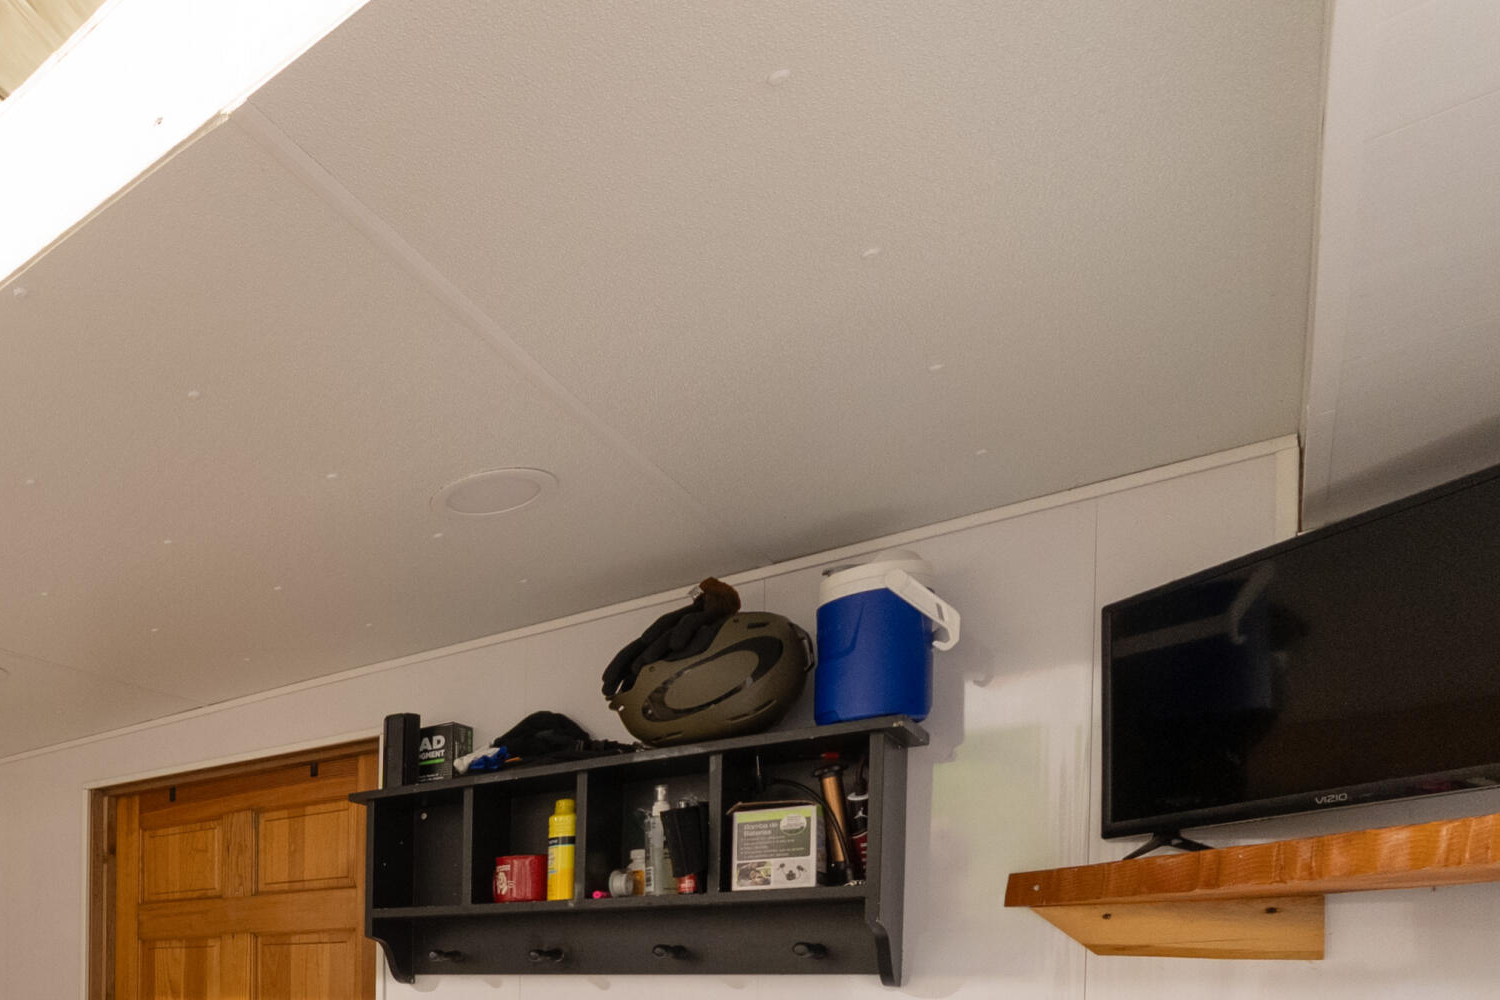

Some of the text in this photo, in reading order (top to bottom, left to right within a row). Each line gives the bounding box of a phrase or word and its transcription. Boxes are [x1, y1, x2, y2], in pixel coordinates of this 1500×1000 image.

[419, 735, 446, 751] AD
[419, 749, 446, 760] GMENT
[1315, 793, 1348, 804] VIZIO
